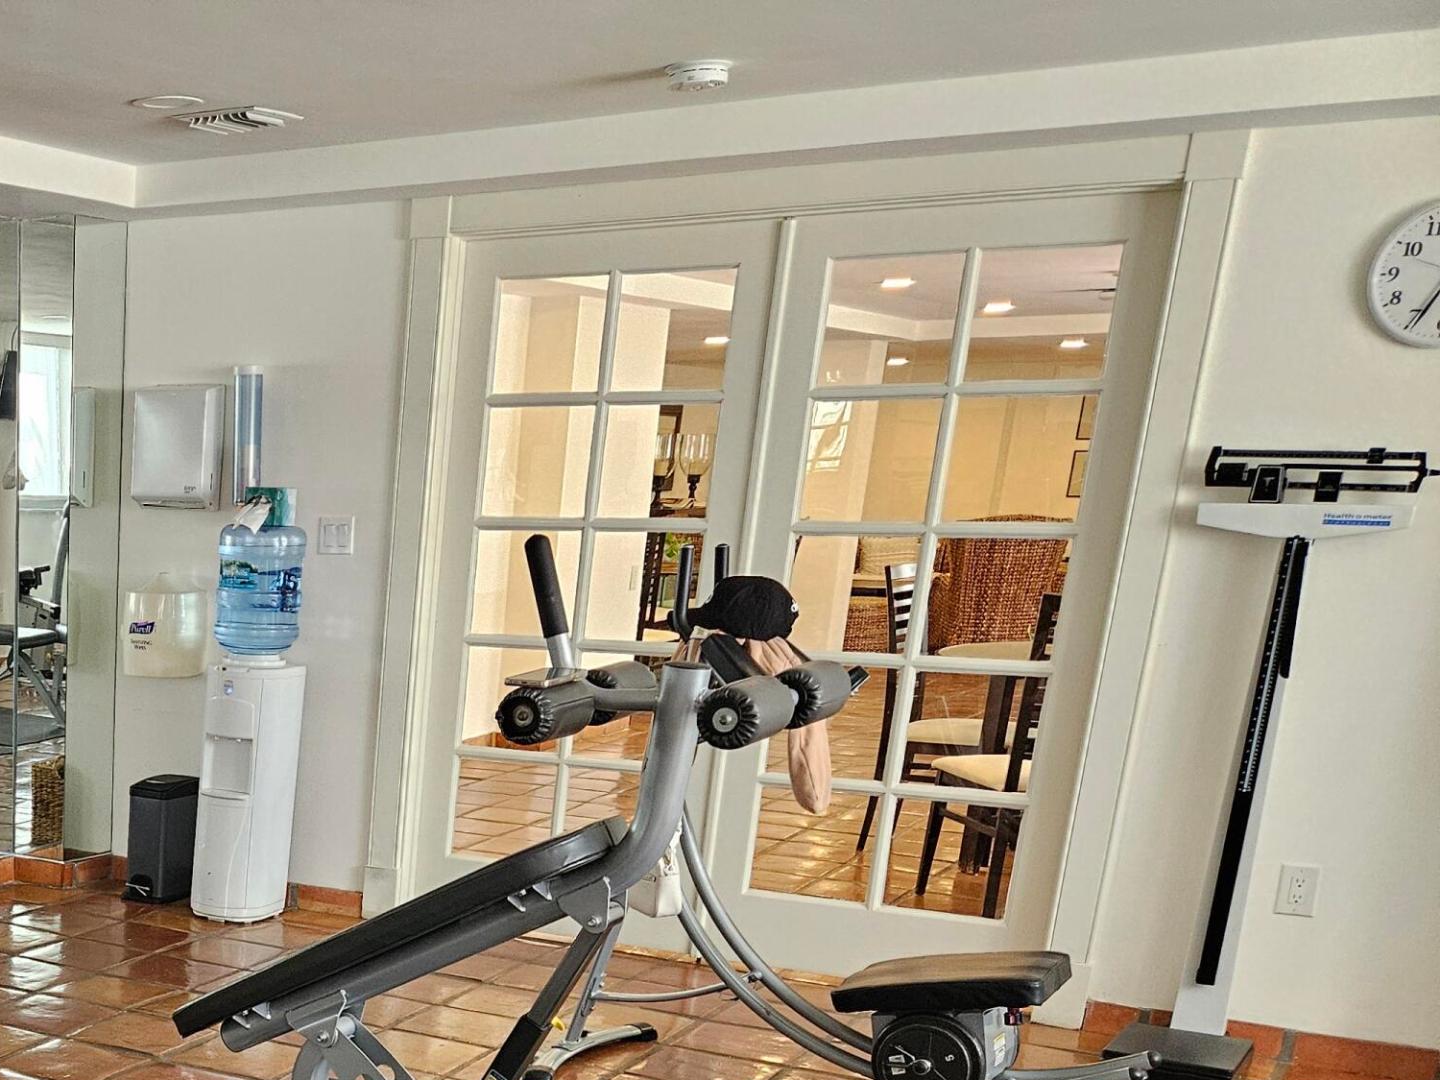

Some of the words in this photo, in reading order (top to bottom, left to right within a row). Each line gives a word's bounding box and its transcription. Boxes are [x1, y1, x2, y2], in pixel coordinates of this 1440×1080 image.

[1402, 241, 1423, 257] 10
[1387, 266, 1400, 282] 9
[1389, 290, 1402, 305] 8
